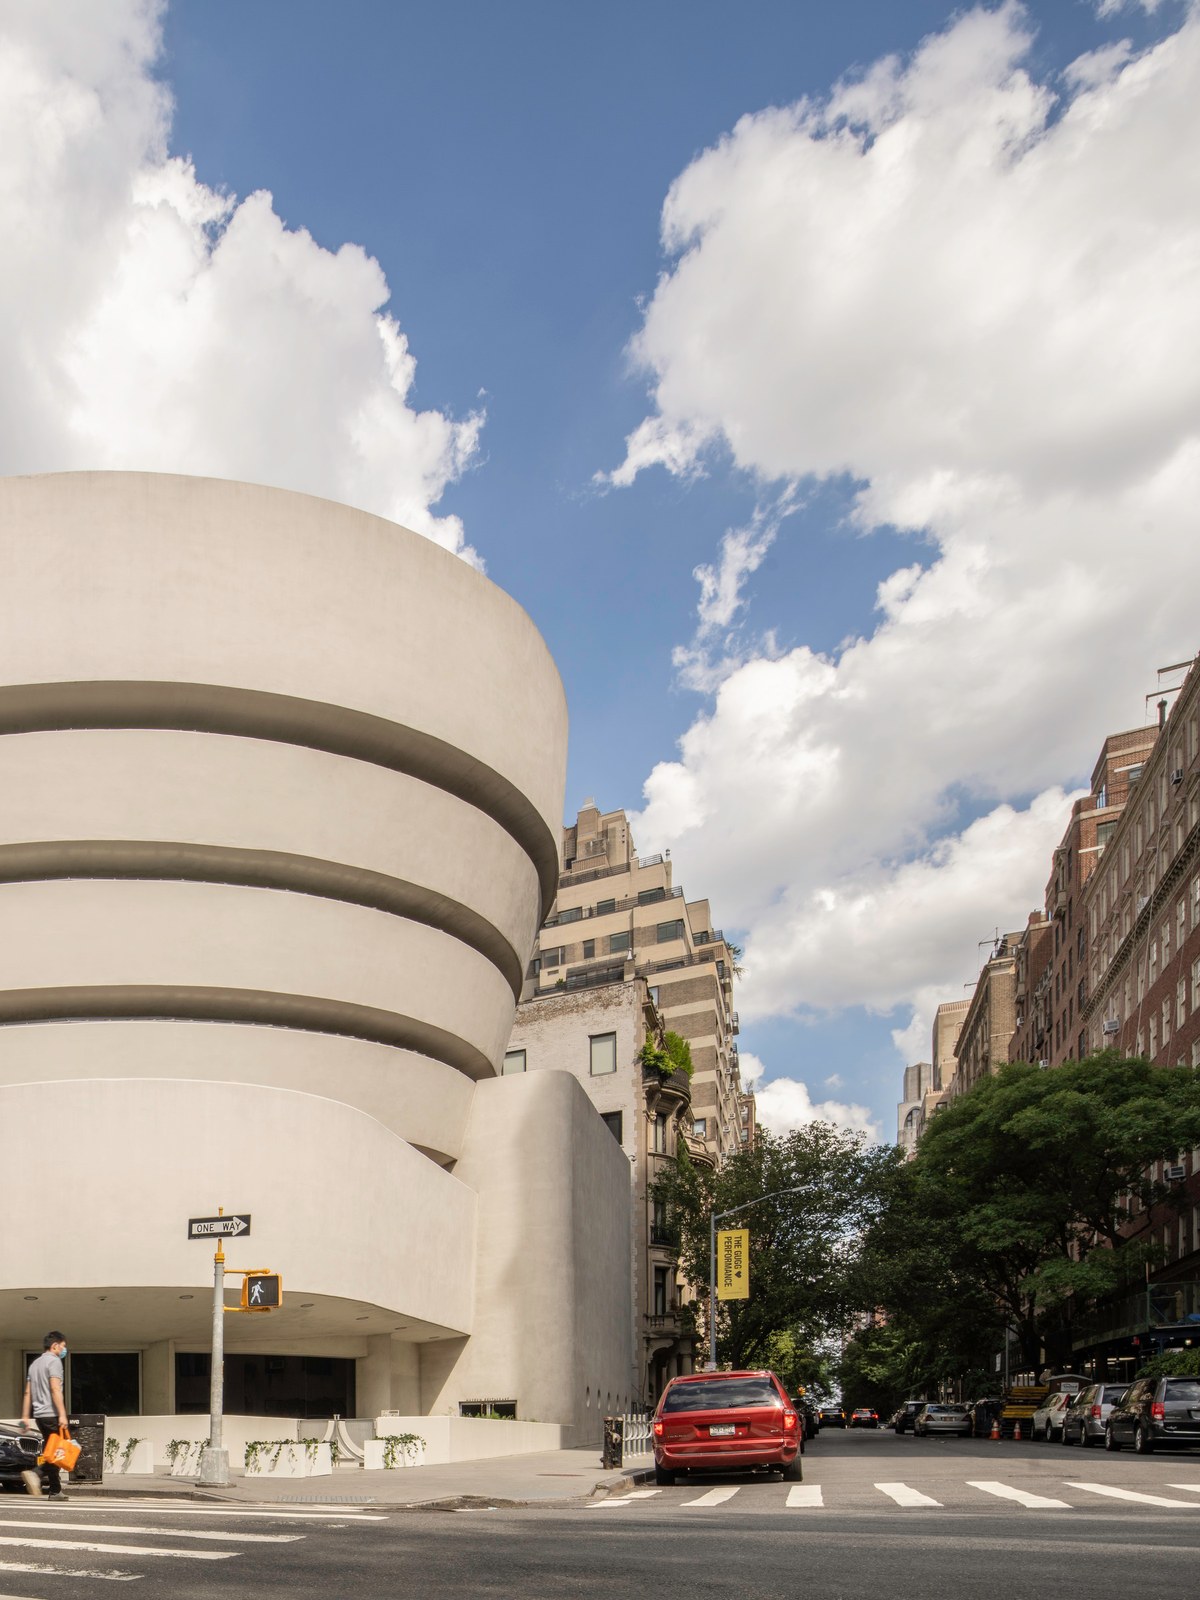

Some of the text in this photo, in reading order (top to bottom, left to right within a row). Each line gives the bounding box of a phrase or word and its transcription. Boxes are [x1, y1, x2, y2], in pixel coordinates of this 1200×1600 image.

[196, 1221, 241, 1233] ONE WAY
[724, 1236, 732, 1287] PERFORMANCE
[734, 1235, 742, 1270] THE GUGG
